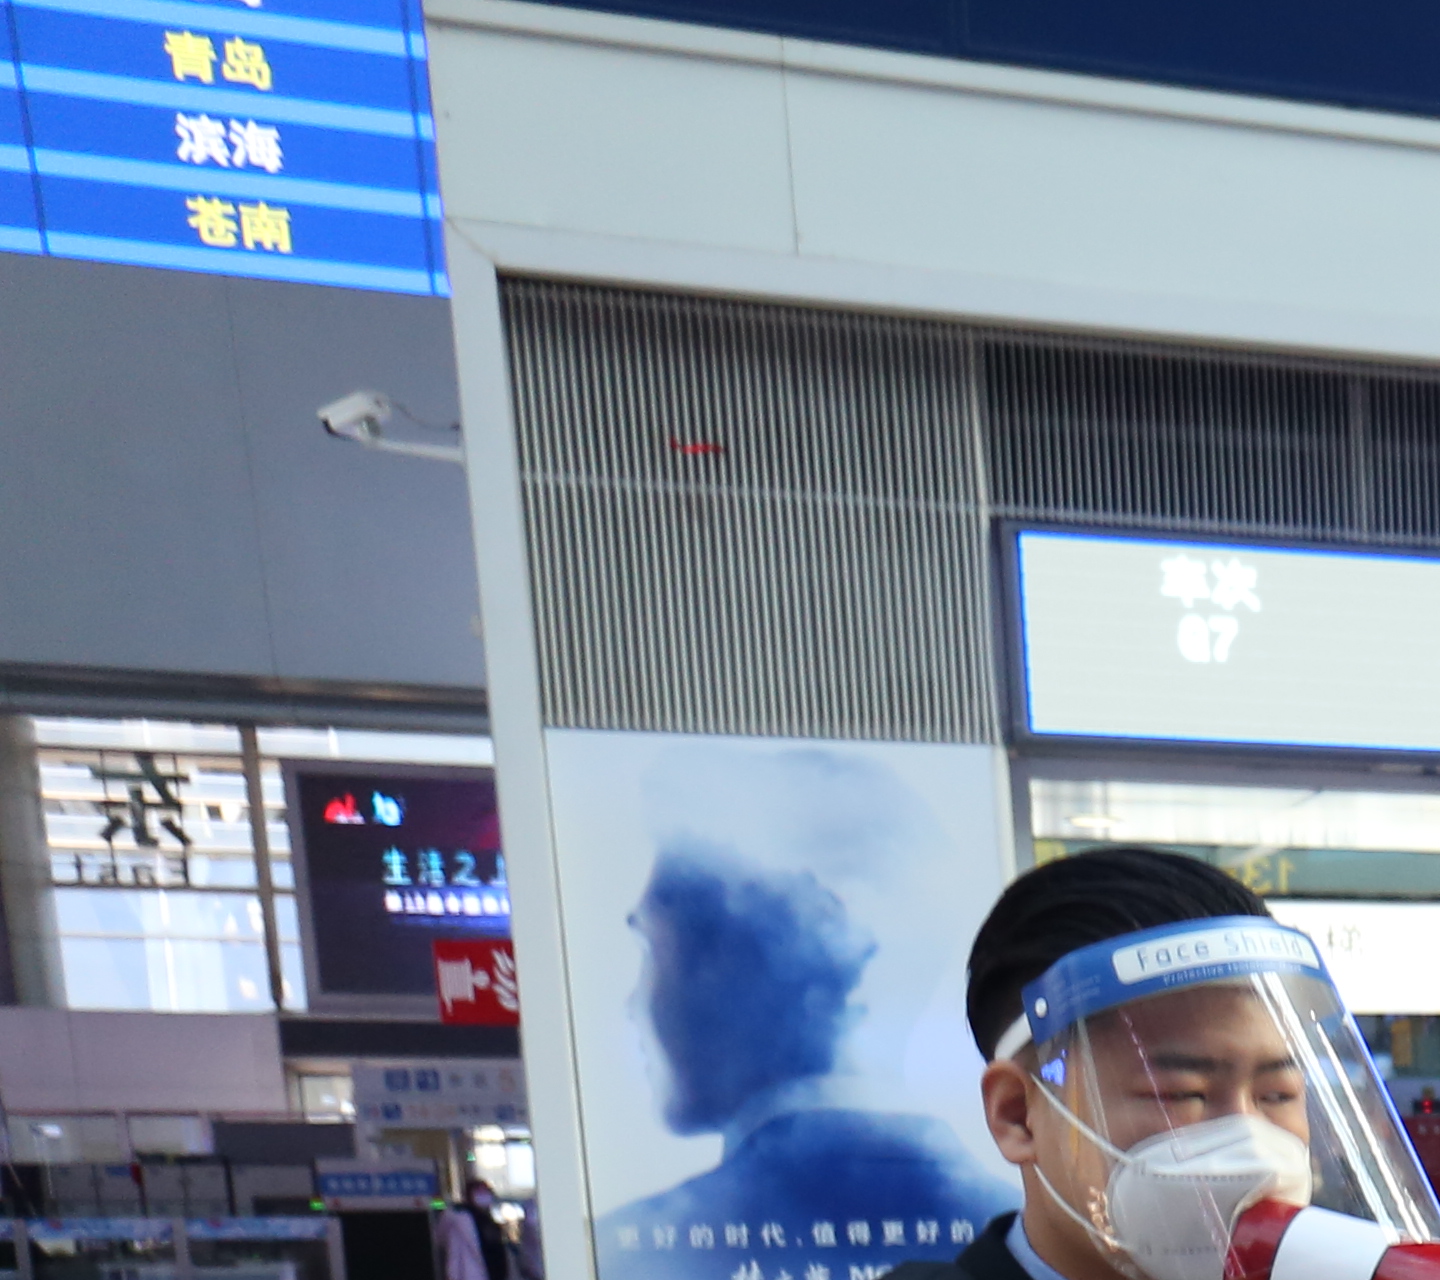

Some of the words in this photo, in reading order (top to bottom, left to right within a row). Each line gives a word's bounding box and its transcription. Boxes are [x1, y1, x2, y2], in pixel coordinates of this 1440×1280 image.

[164, 31, 272, 91] 青岛
[174, 112, 283, 174] 滨海
[185, 195, 292, 254] 苍南
[1160, 555, 1261, 612] 车次
[1137, 937, 1210, 972] Face
[1224, 931, 1303, 959] Shield
